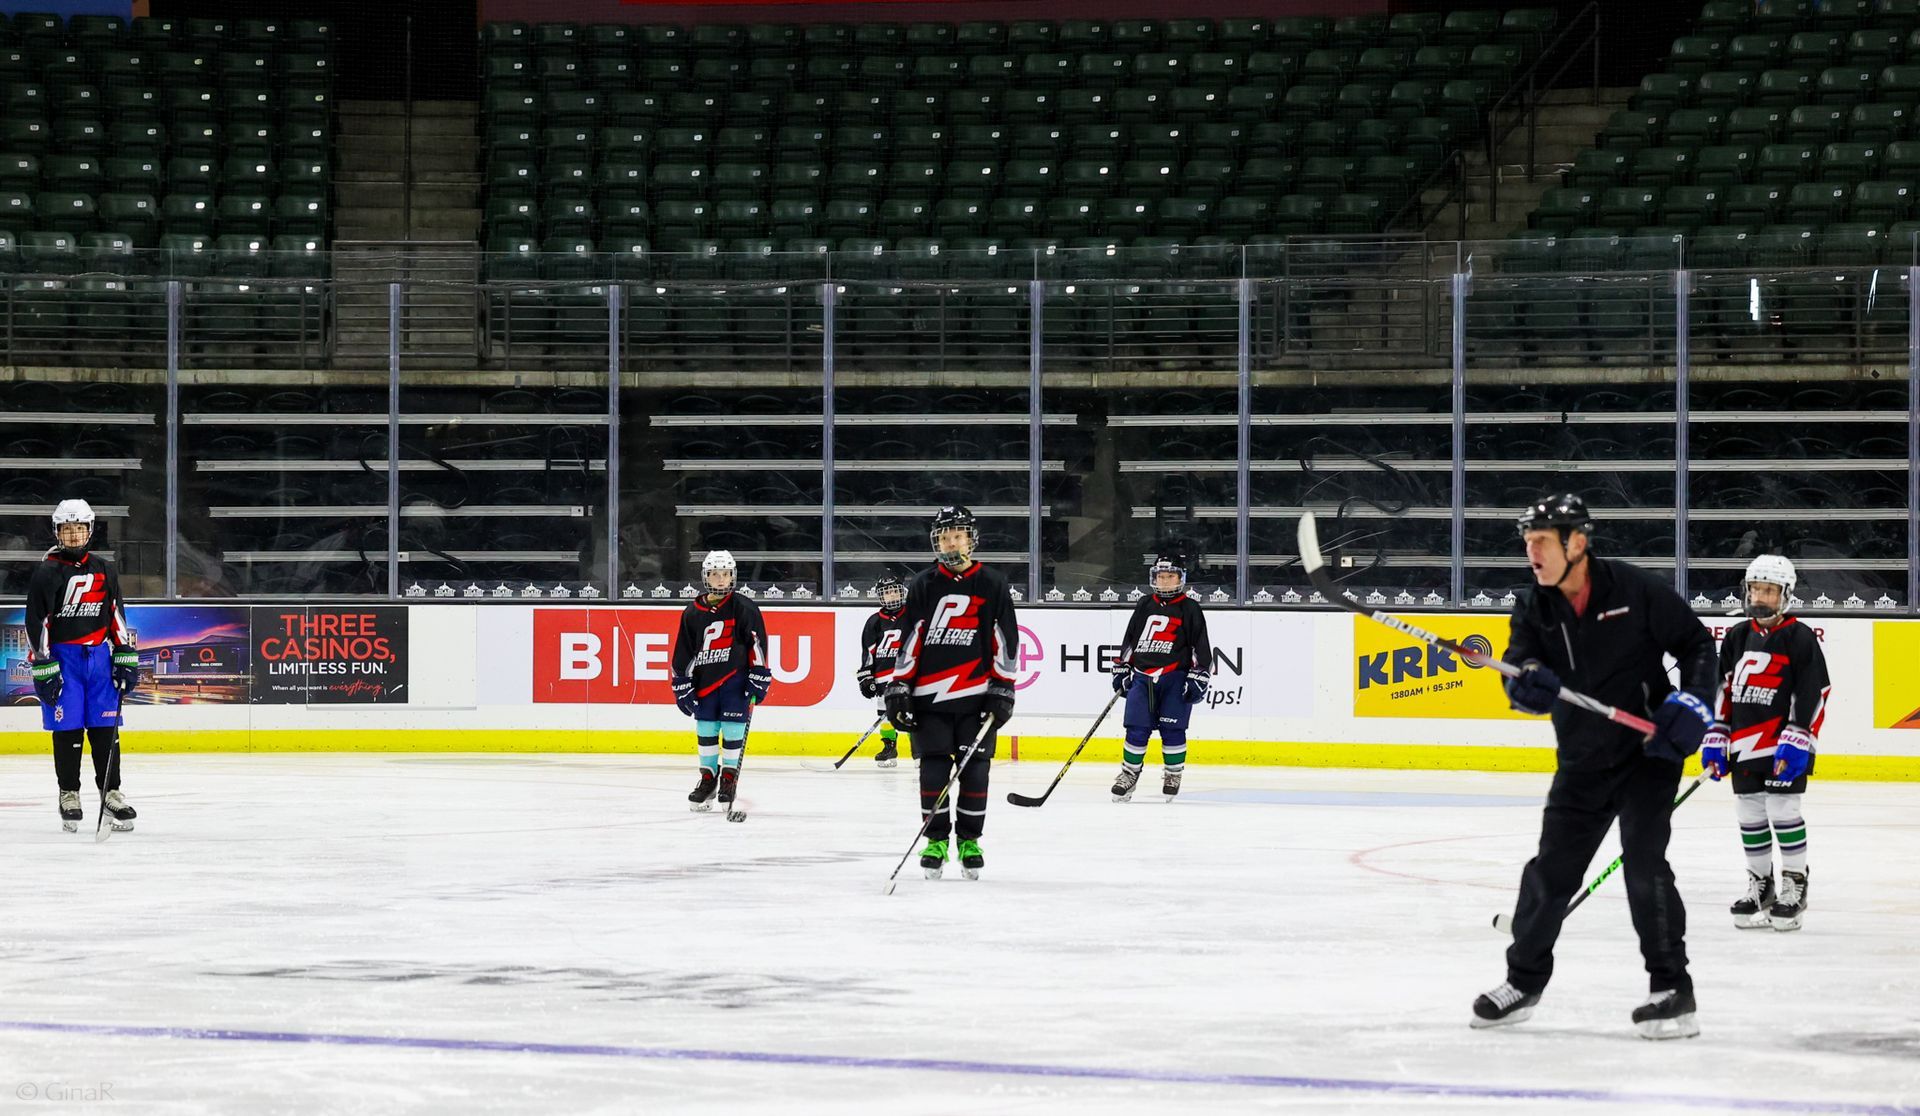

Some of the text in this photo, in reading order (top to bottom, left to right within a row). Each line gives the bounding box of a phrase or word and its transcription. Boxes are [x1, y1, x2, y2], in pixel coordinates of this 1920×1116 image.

[79, 602, 103, 612] EDGE
[280, 614, 377, 636] THREE
[944, 628, 977, 640] EDGE
[260, 637, 396, 663] CASINOS,
[1150, 640, 1174, 650] EDGE
[269, 662, 388, 675] LIMITLESS FUN.
[297, 686, 308, 694] you
[329, 679, 384, 696] everything
[1390, 680, 1464, 700] 1380AM 95.3FM
[1743, 685, 1778, 700] EDGE
[1764, 779, 1793, 788] CCM
